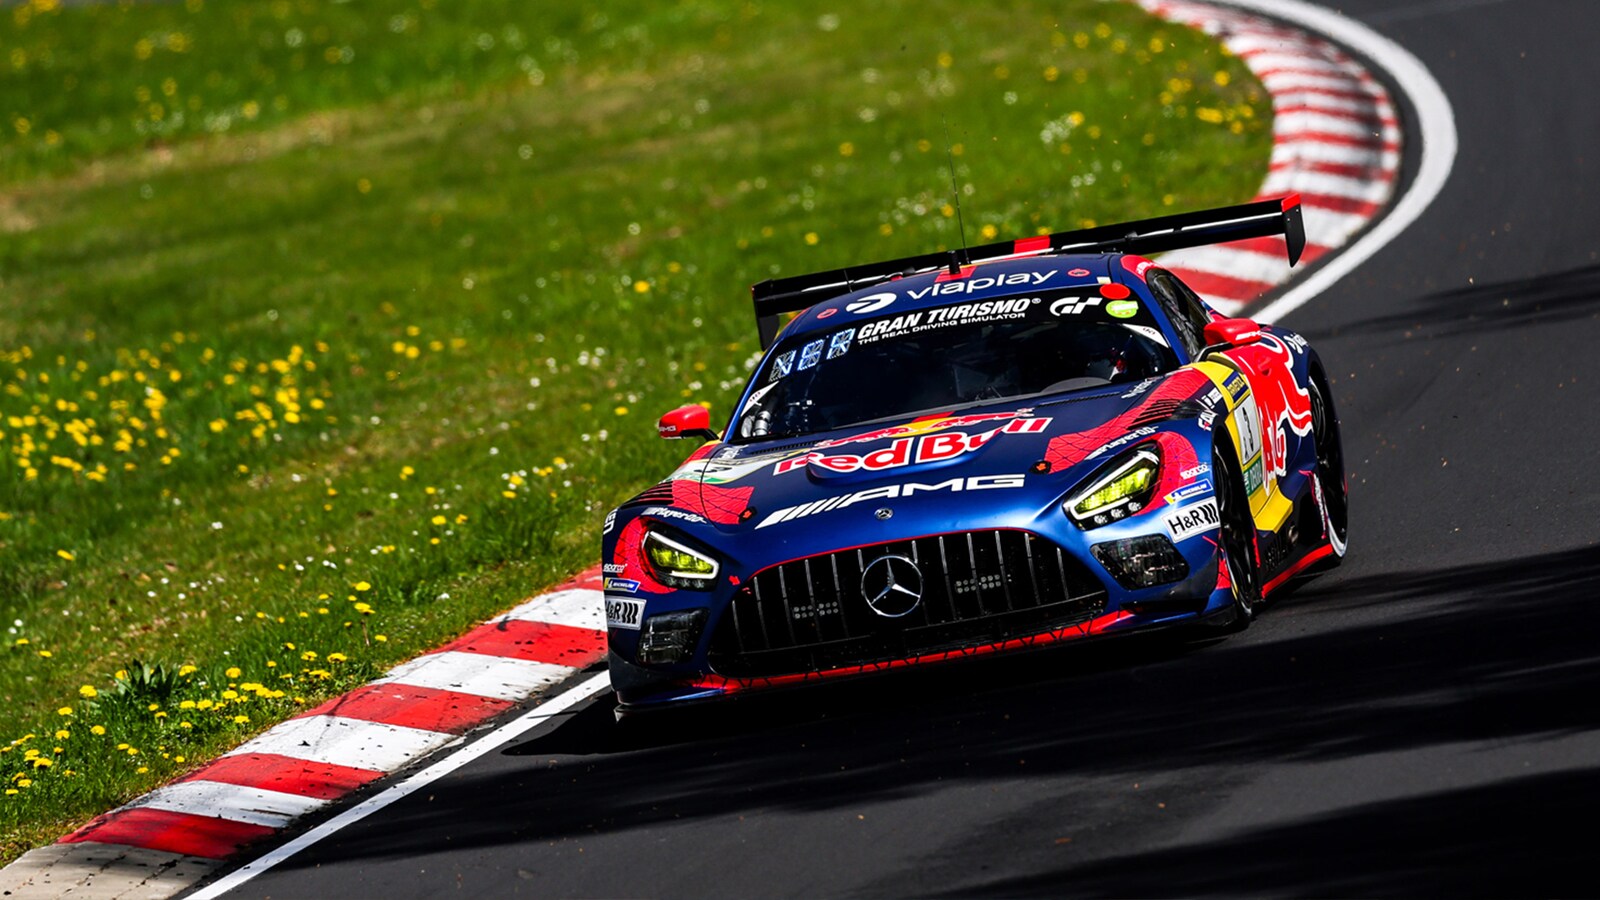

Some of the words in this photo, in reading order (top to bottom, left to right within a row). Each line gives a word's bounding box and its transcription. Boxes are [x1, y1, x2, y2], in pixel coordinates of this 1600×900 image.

[906, 269, 1058, 300] viaplay
[857, 313, 922, 340] GRAN
[857, 336, 879, 346] THE
[881, 329, 910, 341] REAL
[912, 319, 958, 333] DRIVING
[960, 312, 1026, 326] SIMULATOR
[773, 438, 913, 476] Red
[915, 417, 1054, 464] Bull
[1168, 509, 1205, 535] H&R
